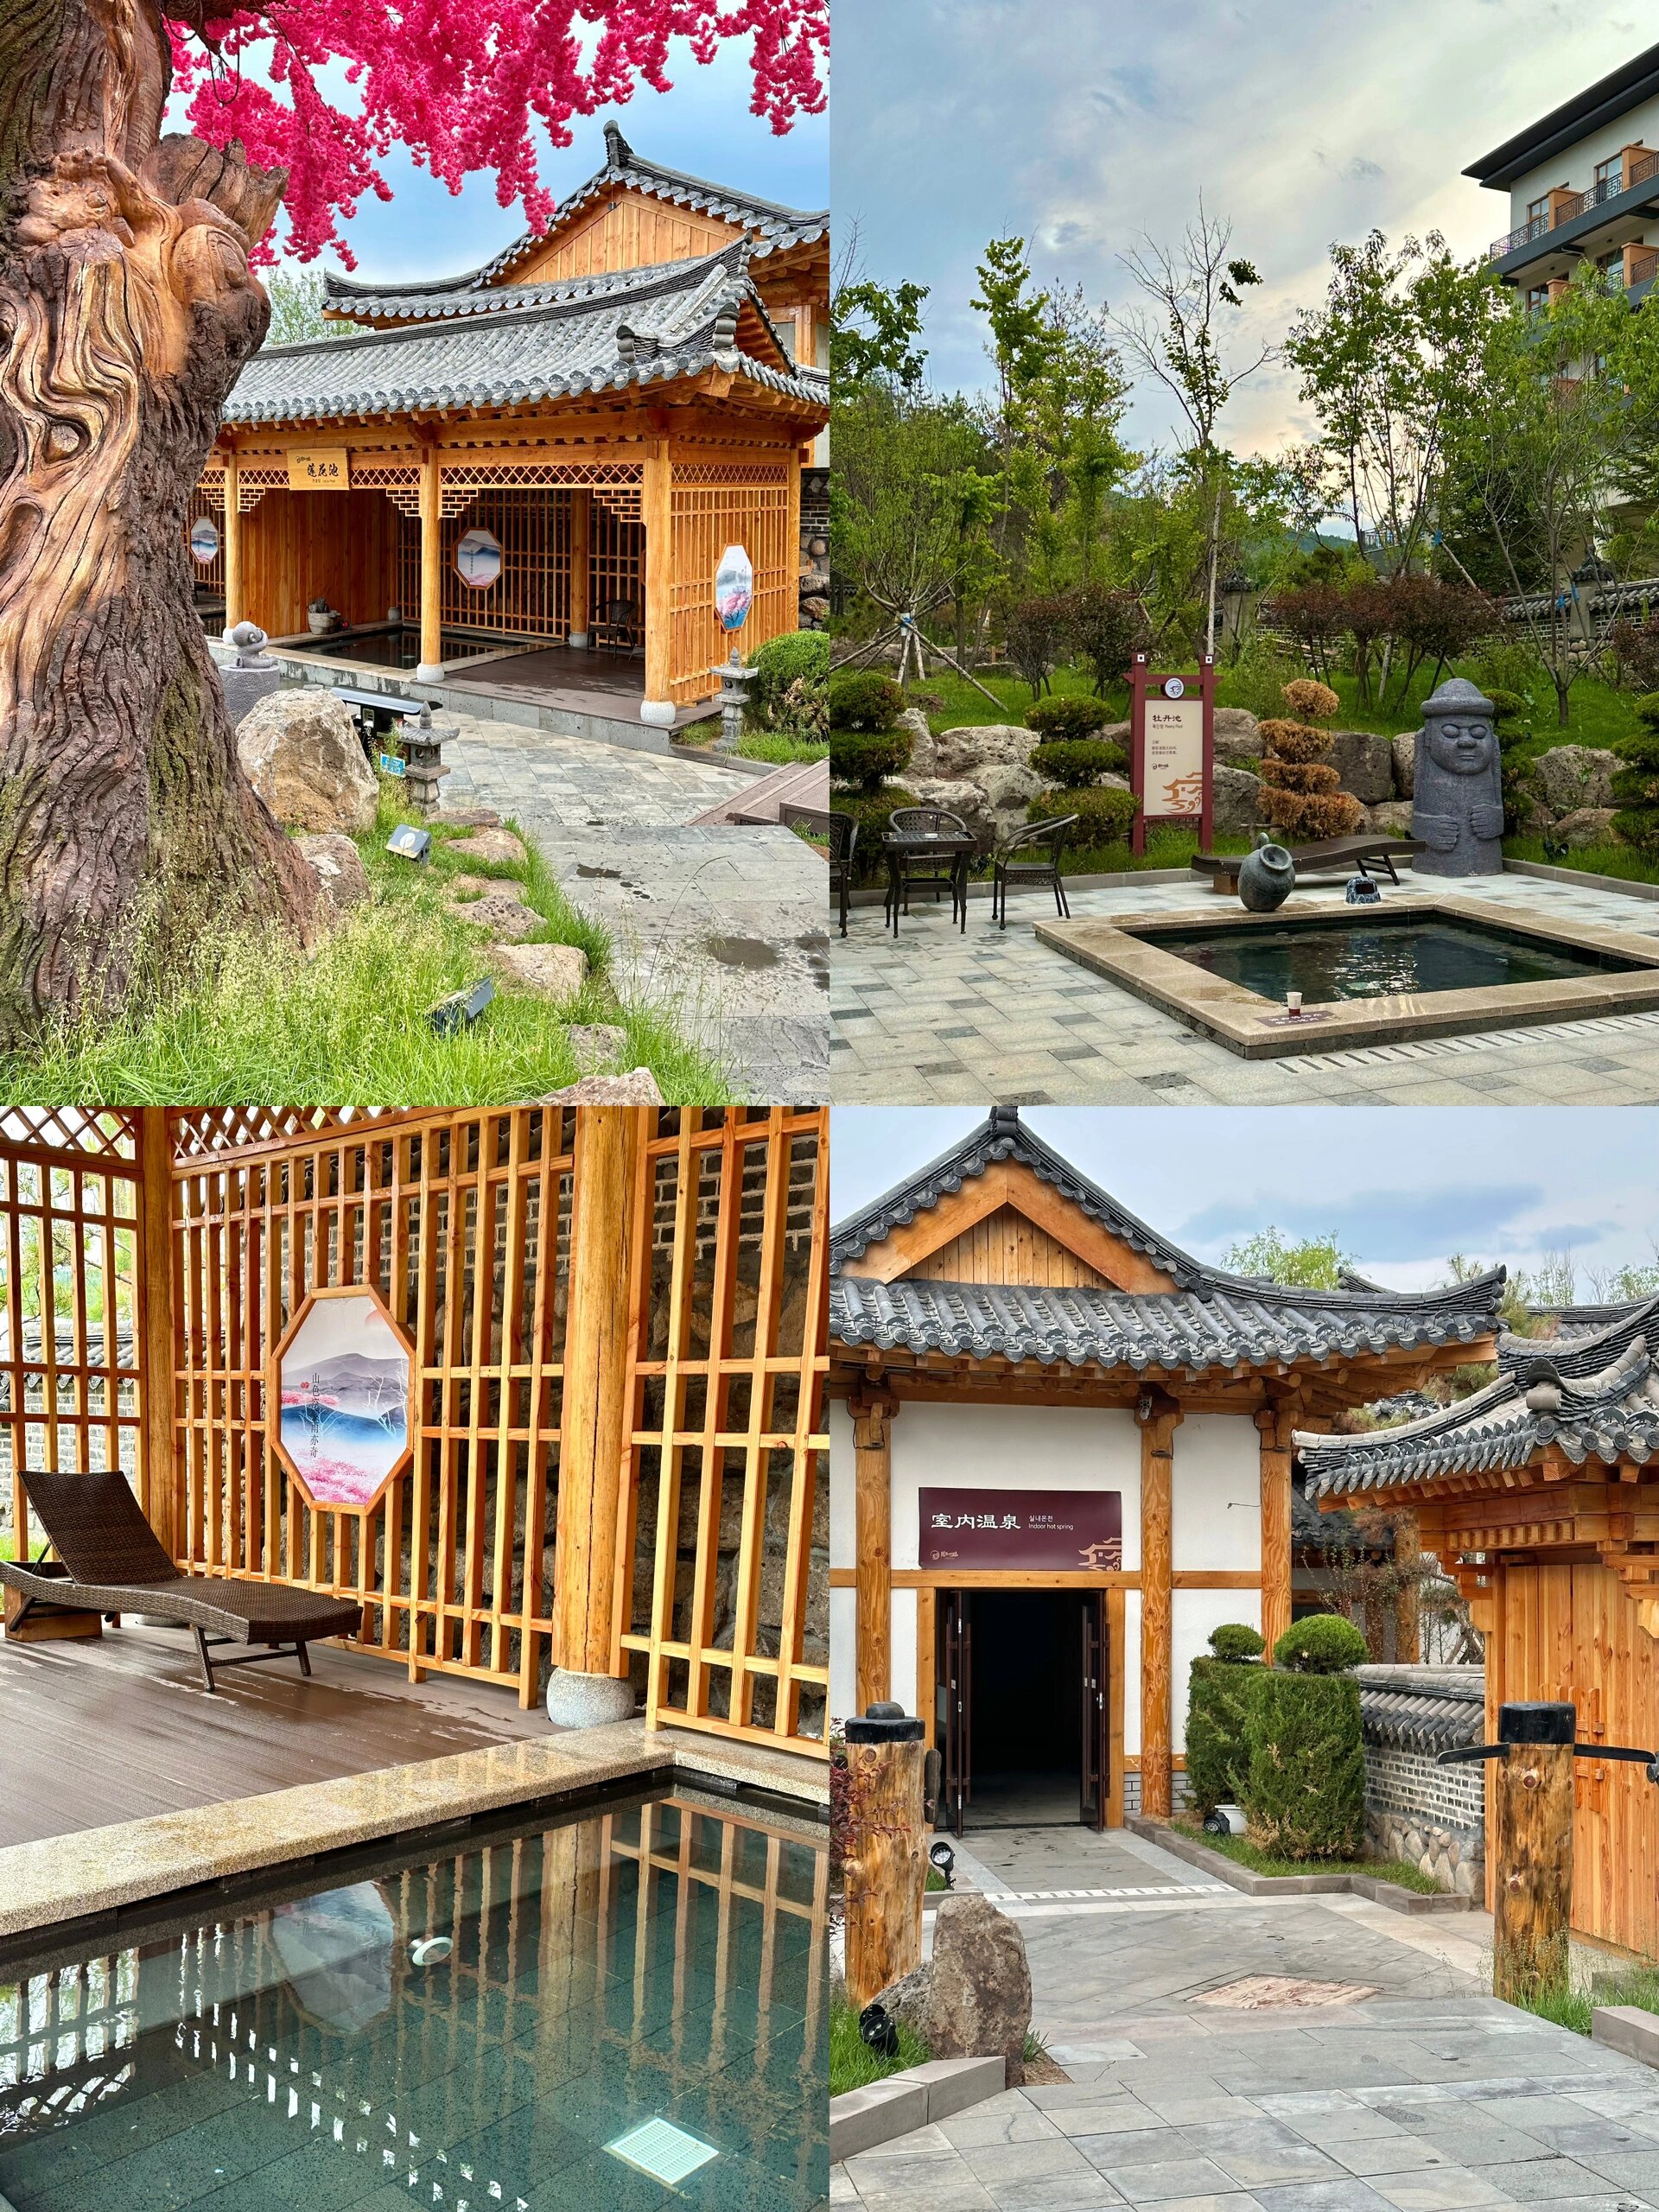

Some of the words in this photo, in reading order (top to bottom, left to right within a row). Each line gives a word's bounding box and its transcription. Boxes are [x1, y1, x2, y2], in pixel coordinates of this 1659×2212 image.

[310, 1372, 320, 1458] 山色空雨亦奇
[931, 1513, 1021, 1529] 室内温泉
